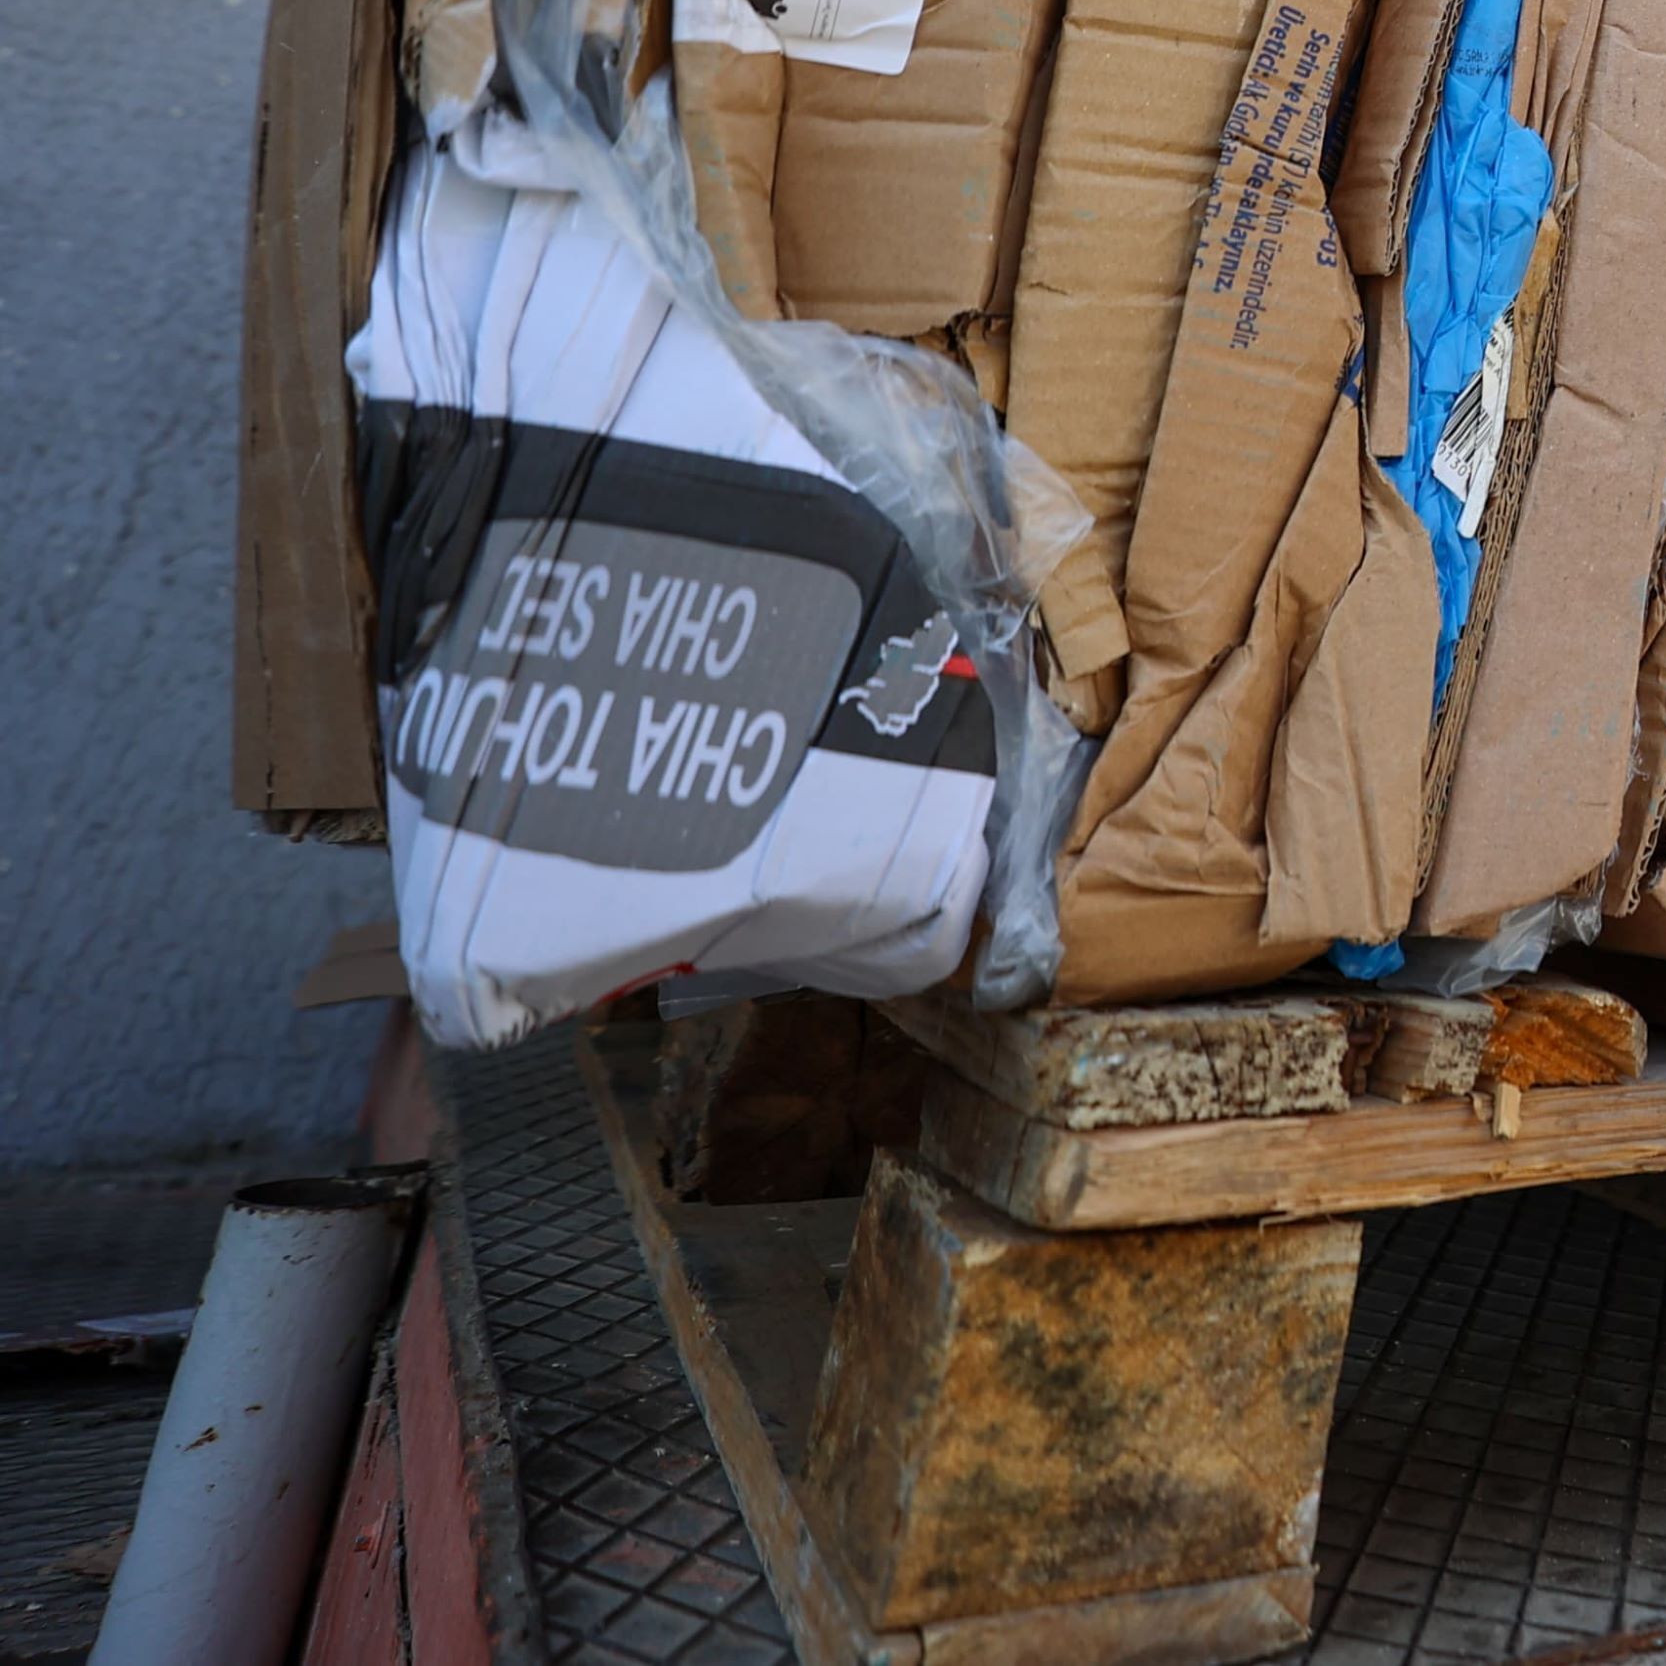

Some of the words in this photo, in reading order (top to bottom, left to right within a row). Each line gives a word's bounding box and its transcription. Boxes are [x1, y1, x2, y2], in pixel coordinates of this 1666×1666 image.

[1251, 4, 1306, 79] Üretici:
[1293, 27, 1331, 82] Serin
[1241, 78, 1271, 103] Ak
[1263, 101, 1302, 151] kuru
[1283, 82, 1306, 104] ve
[1212, 186, 1263, 295] saklayınız.
[1228, 234, 1284, 350] üzerindedir.
[615, 570, 758, 681] CHIA
[627, 695, 787, 808] CHIA
